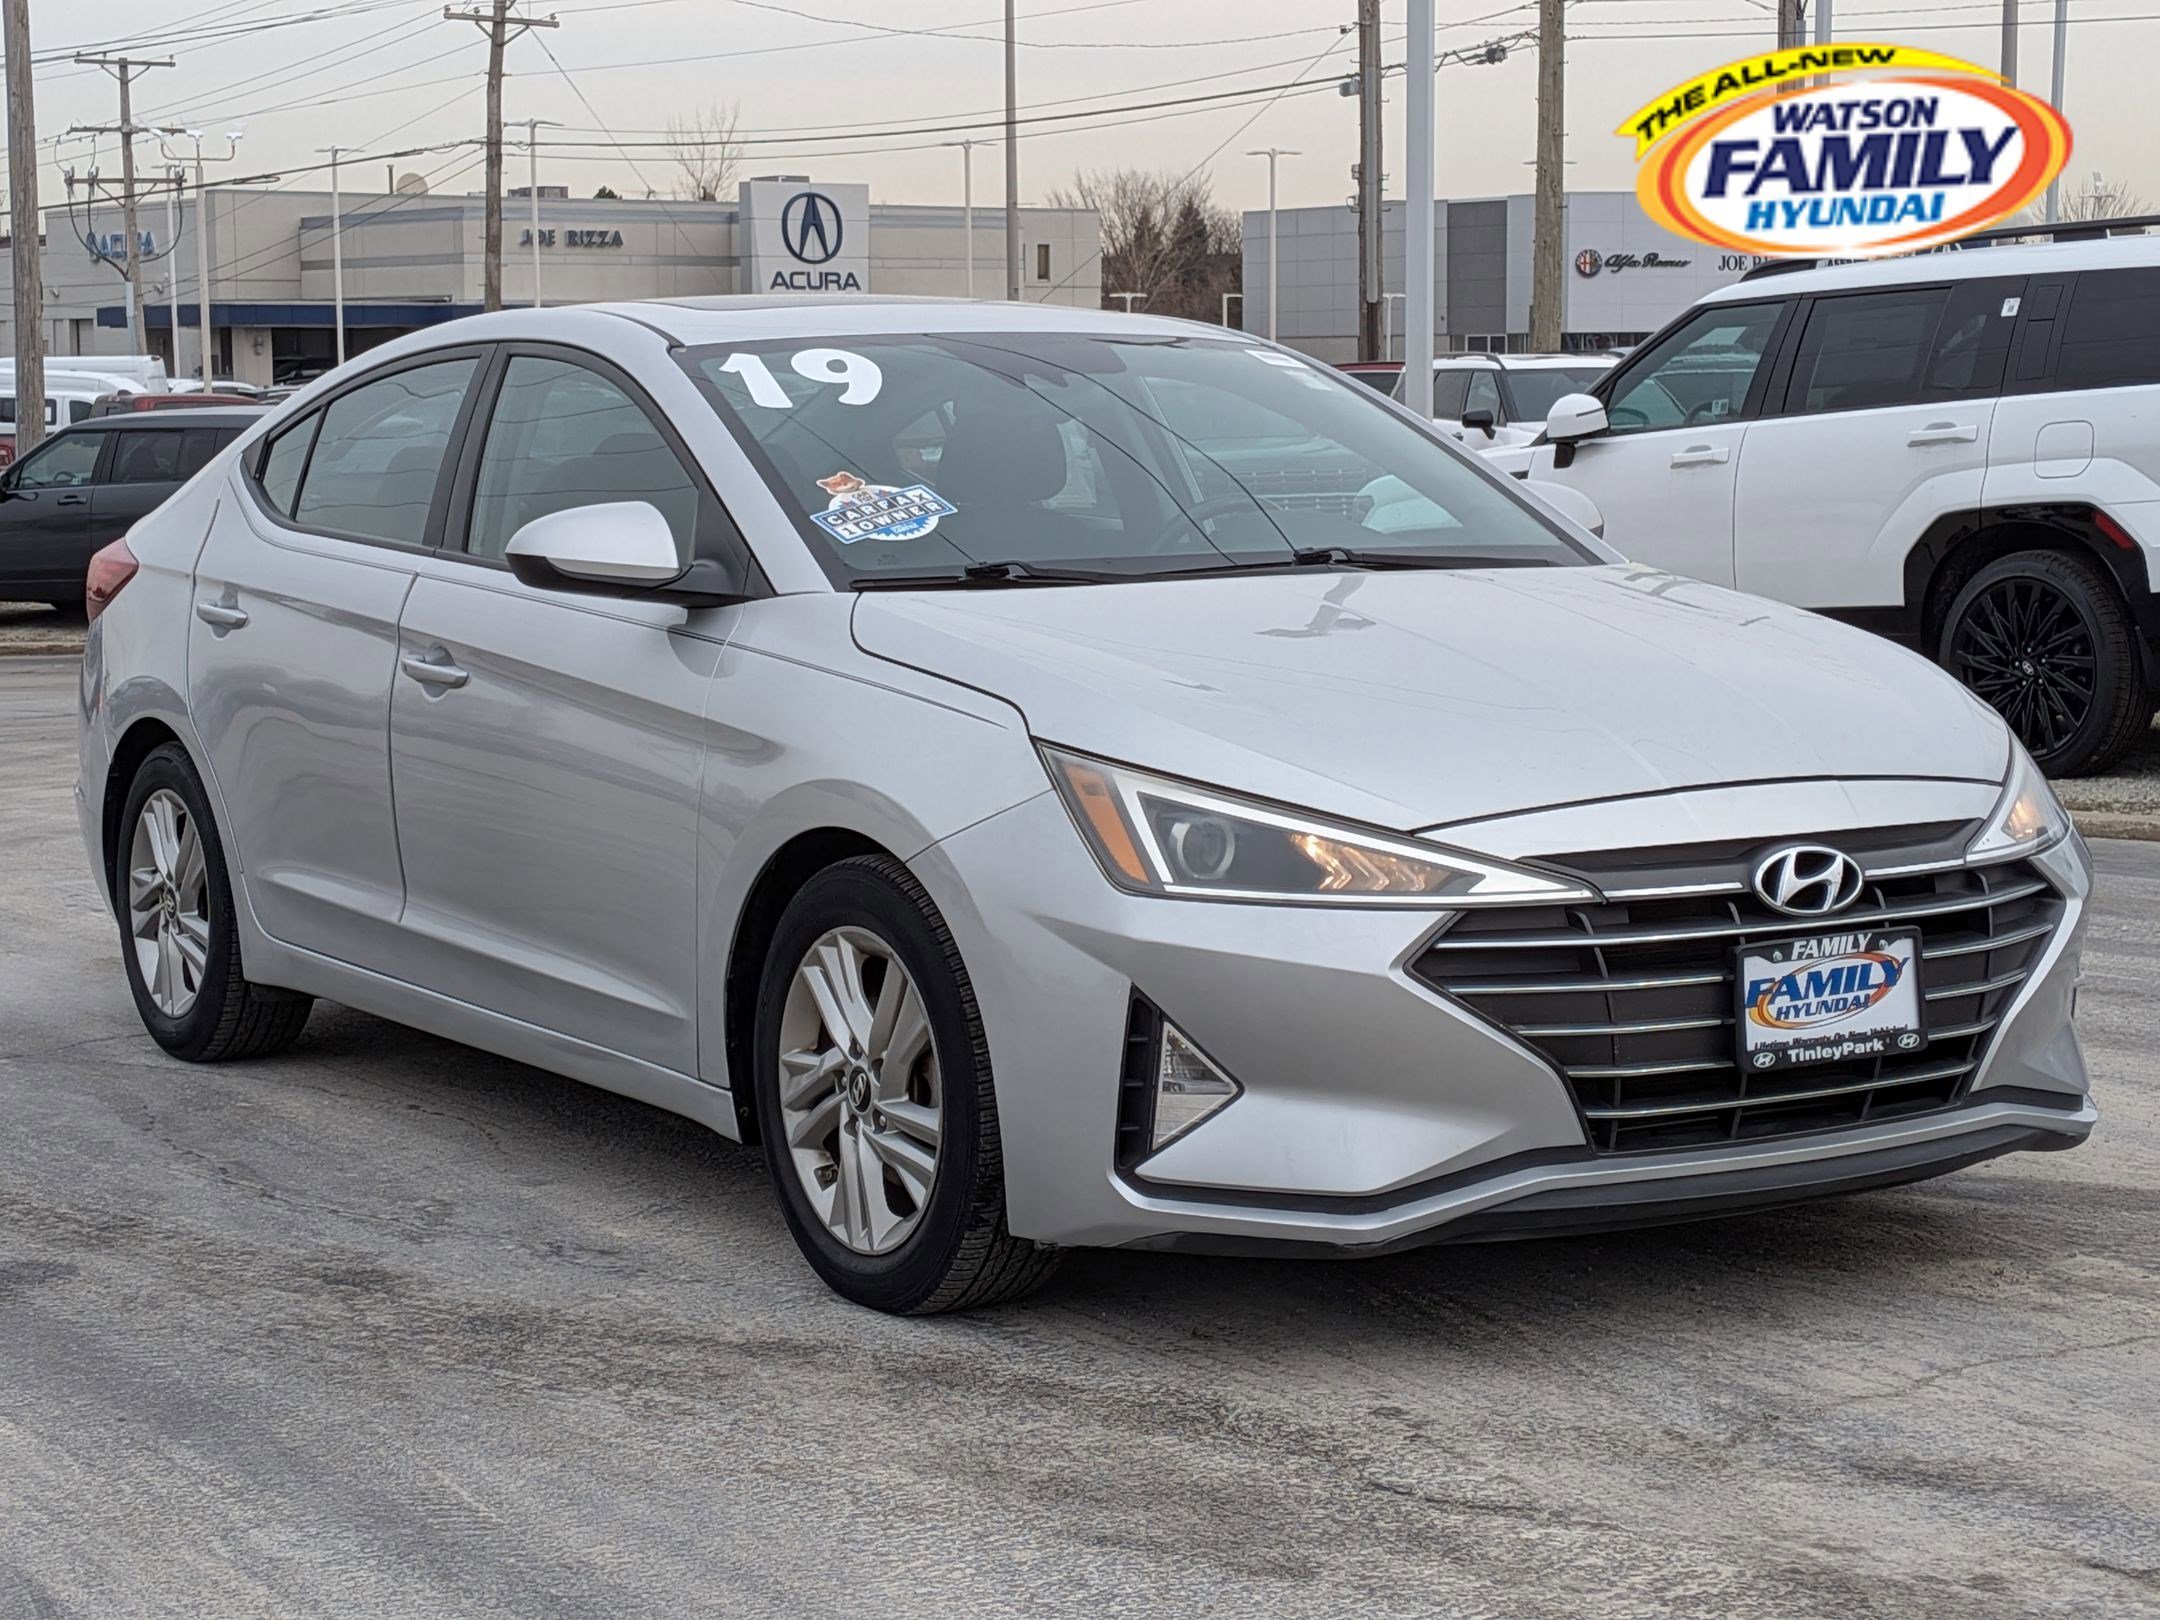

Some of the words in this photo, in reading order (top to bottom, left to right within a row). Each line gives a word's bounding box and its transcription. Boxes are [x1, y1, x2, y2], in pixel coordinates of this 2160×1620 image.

[101, 231, 156, 259] ACA
[519, 228, 556, 247] JOE
[565, 228, 624, 248] RIZZA
[1604, 253, 1641, 273] Alfa
[1642, 252, 1691, 268] Romeo
[1718, 254, 1748, 271] JOE
[770, 271, 862, 291] ACURA
[719, 348, 882, 408] 19
[826, 492, 930, 525] CARFAX
[858, 501, 943, 531] OWNER
[1791, 933, 1872, 960] FAMILY
[1745, 957, 1910, 1008] FAMILY
[1775, 993, 1871, 1021] HYUNDAI
[1788, 1038, 1885, 1063] TinleyPark
